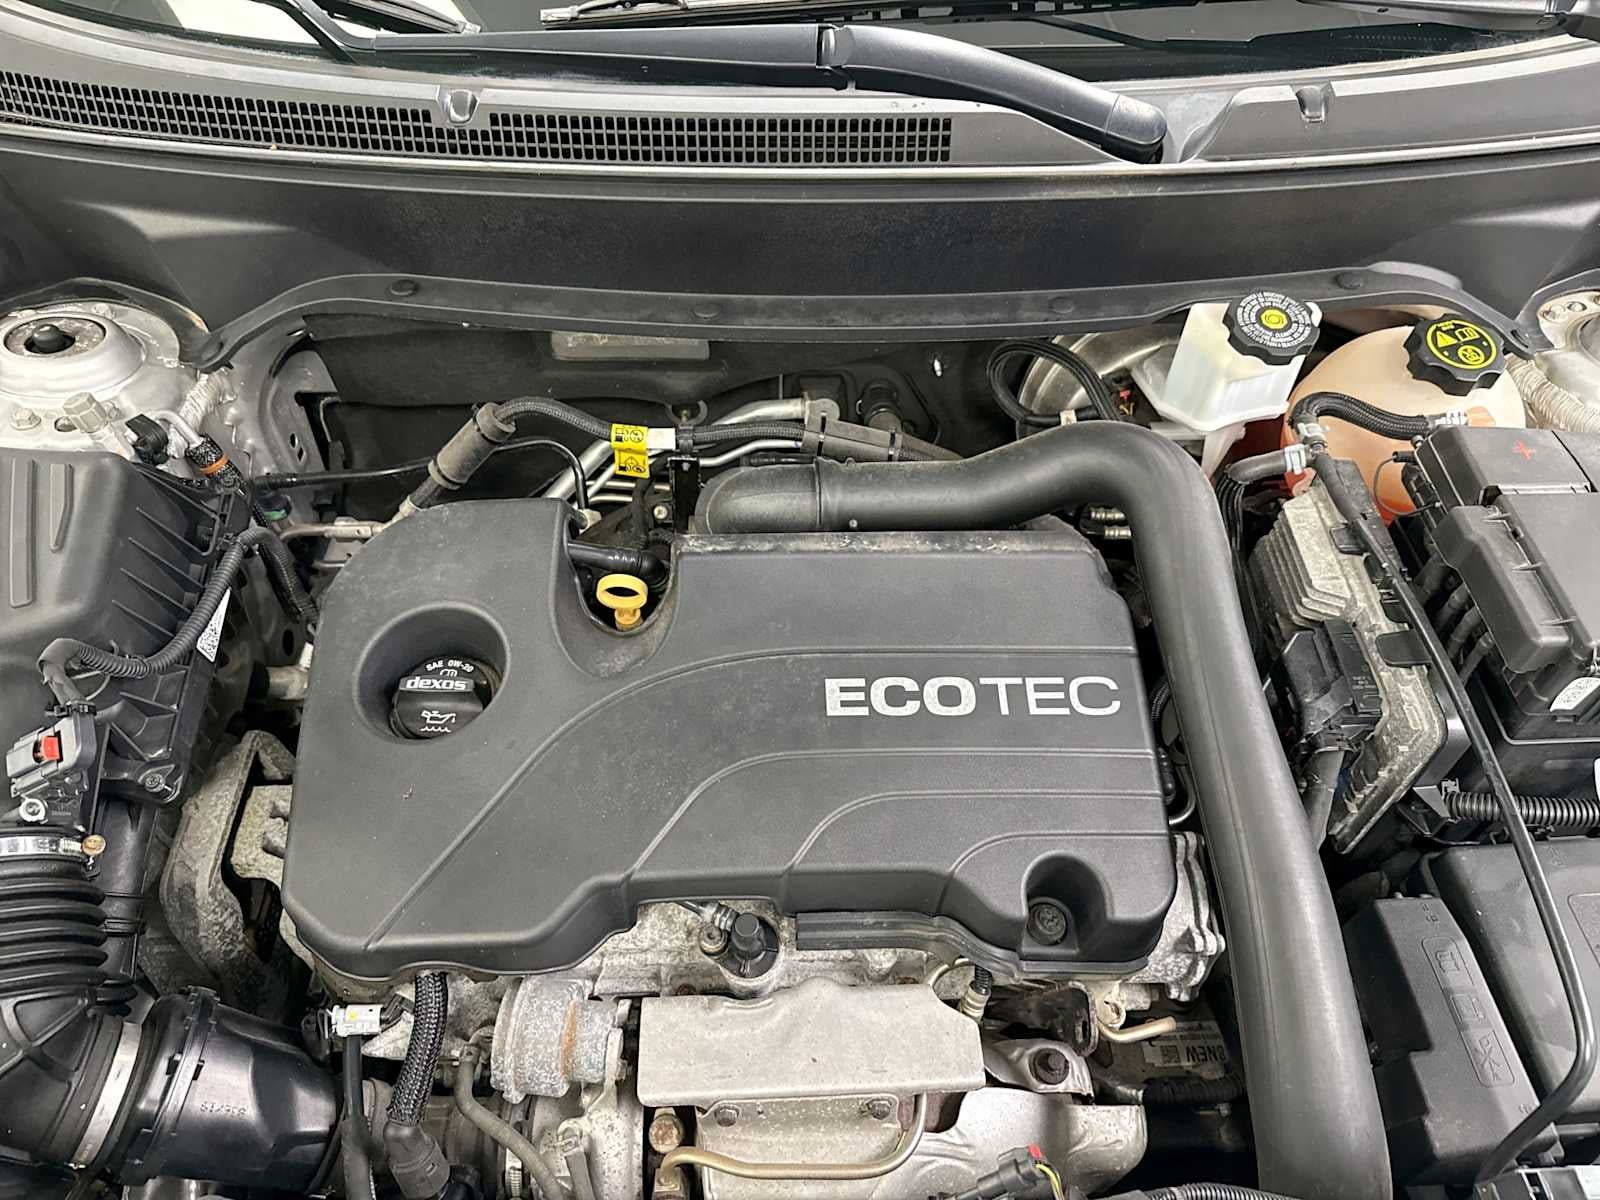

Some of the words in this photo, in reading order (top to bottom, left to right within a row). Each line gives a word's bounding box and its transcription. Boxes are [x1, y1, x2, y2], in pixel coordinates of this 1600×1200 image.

[426, 660, 444, 671] SAE
[447, 660, 474, 673] 0W-20
[406, 676, 466, 690] dexos
[824, 676, 1121, 717] ECOTEC
